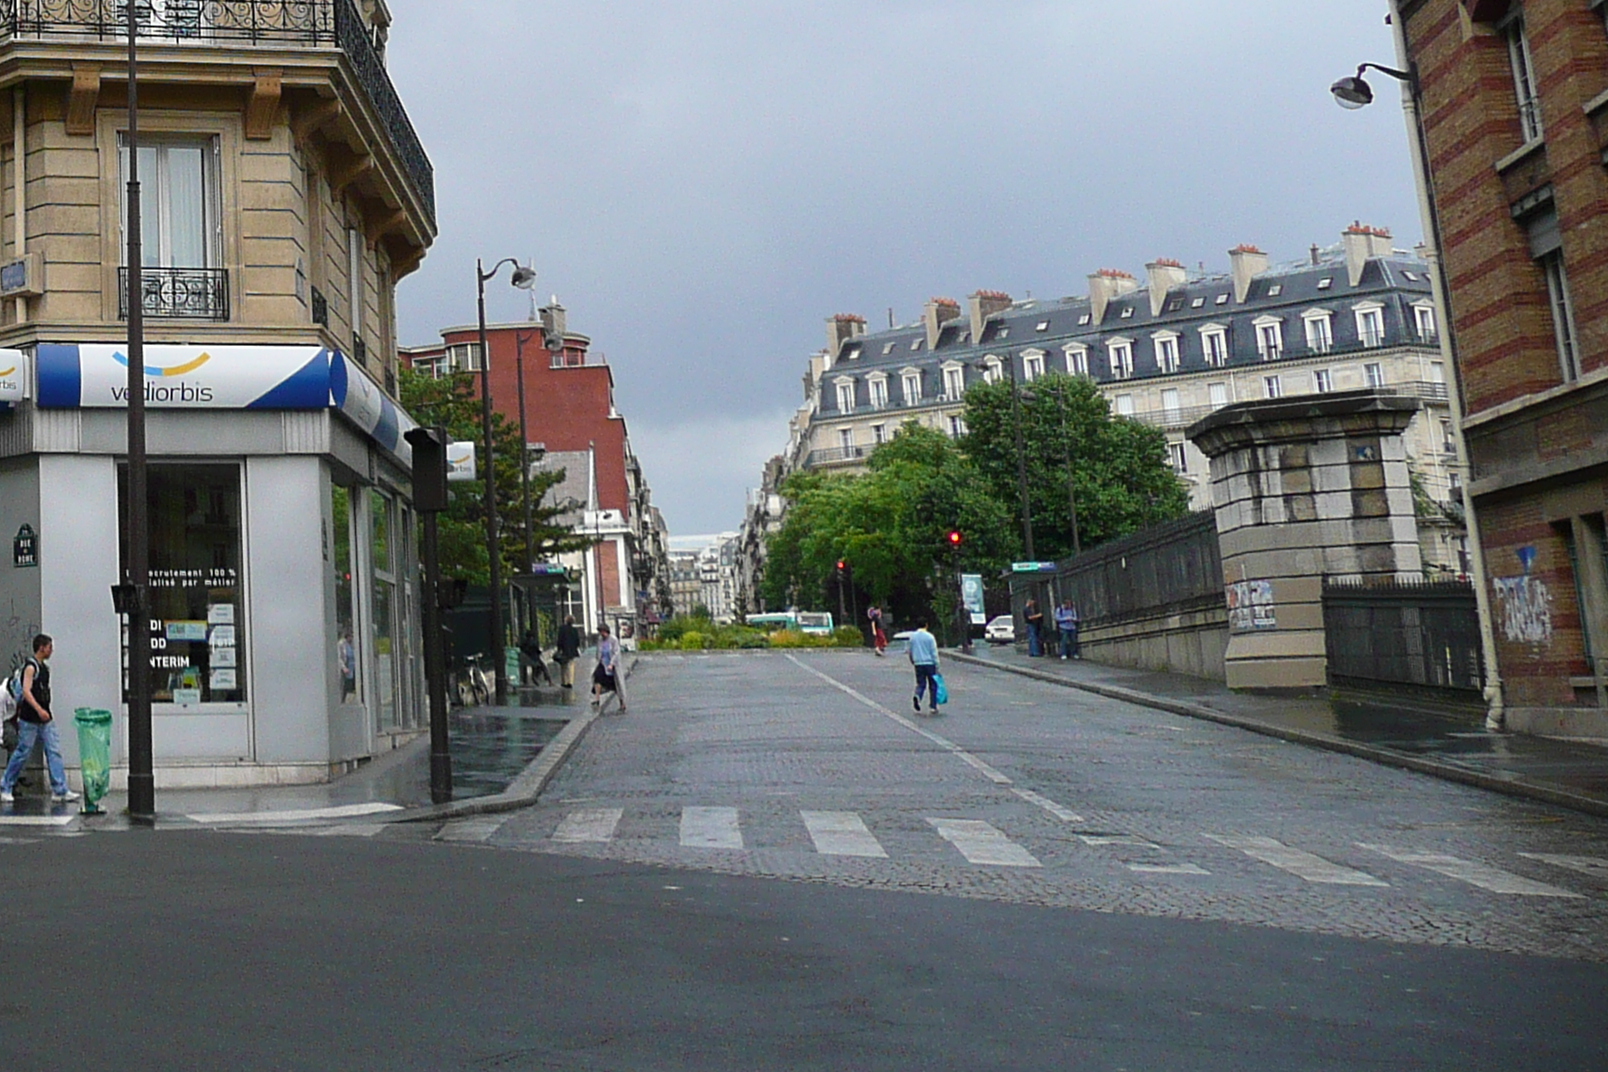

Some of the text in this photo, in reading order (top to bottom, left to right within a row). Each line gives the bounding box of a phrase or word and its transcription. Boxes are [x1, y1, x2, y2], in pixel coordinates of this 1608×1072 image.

[148, 569, 202, 577] ecrutement
[209, 568, 225, 577] 100
[182, 579, 198, 588] par
[204, 577, 235, 586] métier
[150, 619, 162, 631] DI
[150, 637, 167, 649] DD
[149, 656, 190, 668] NTERIM
